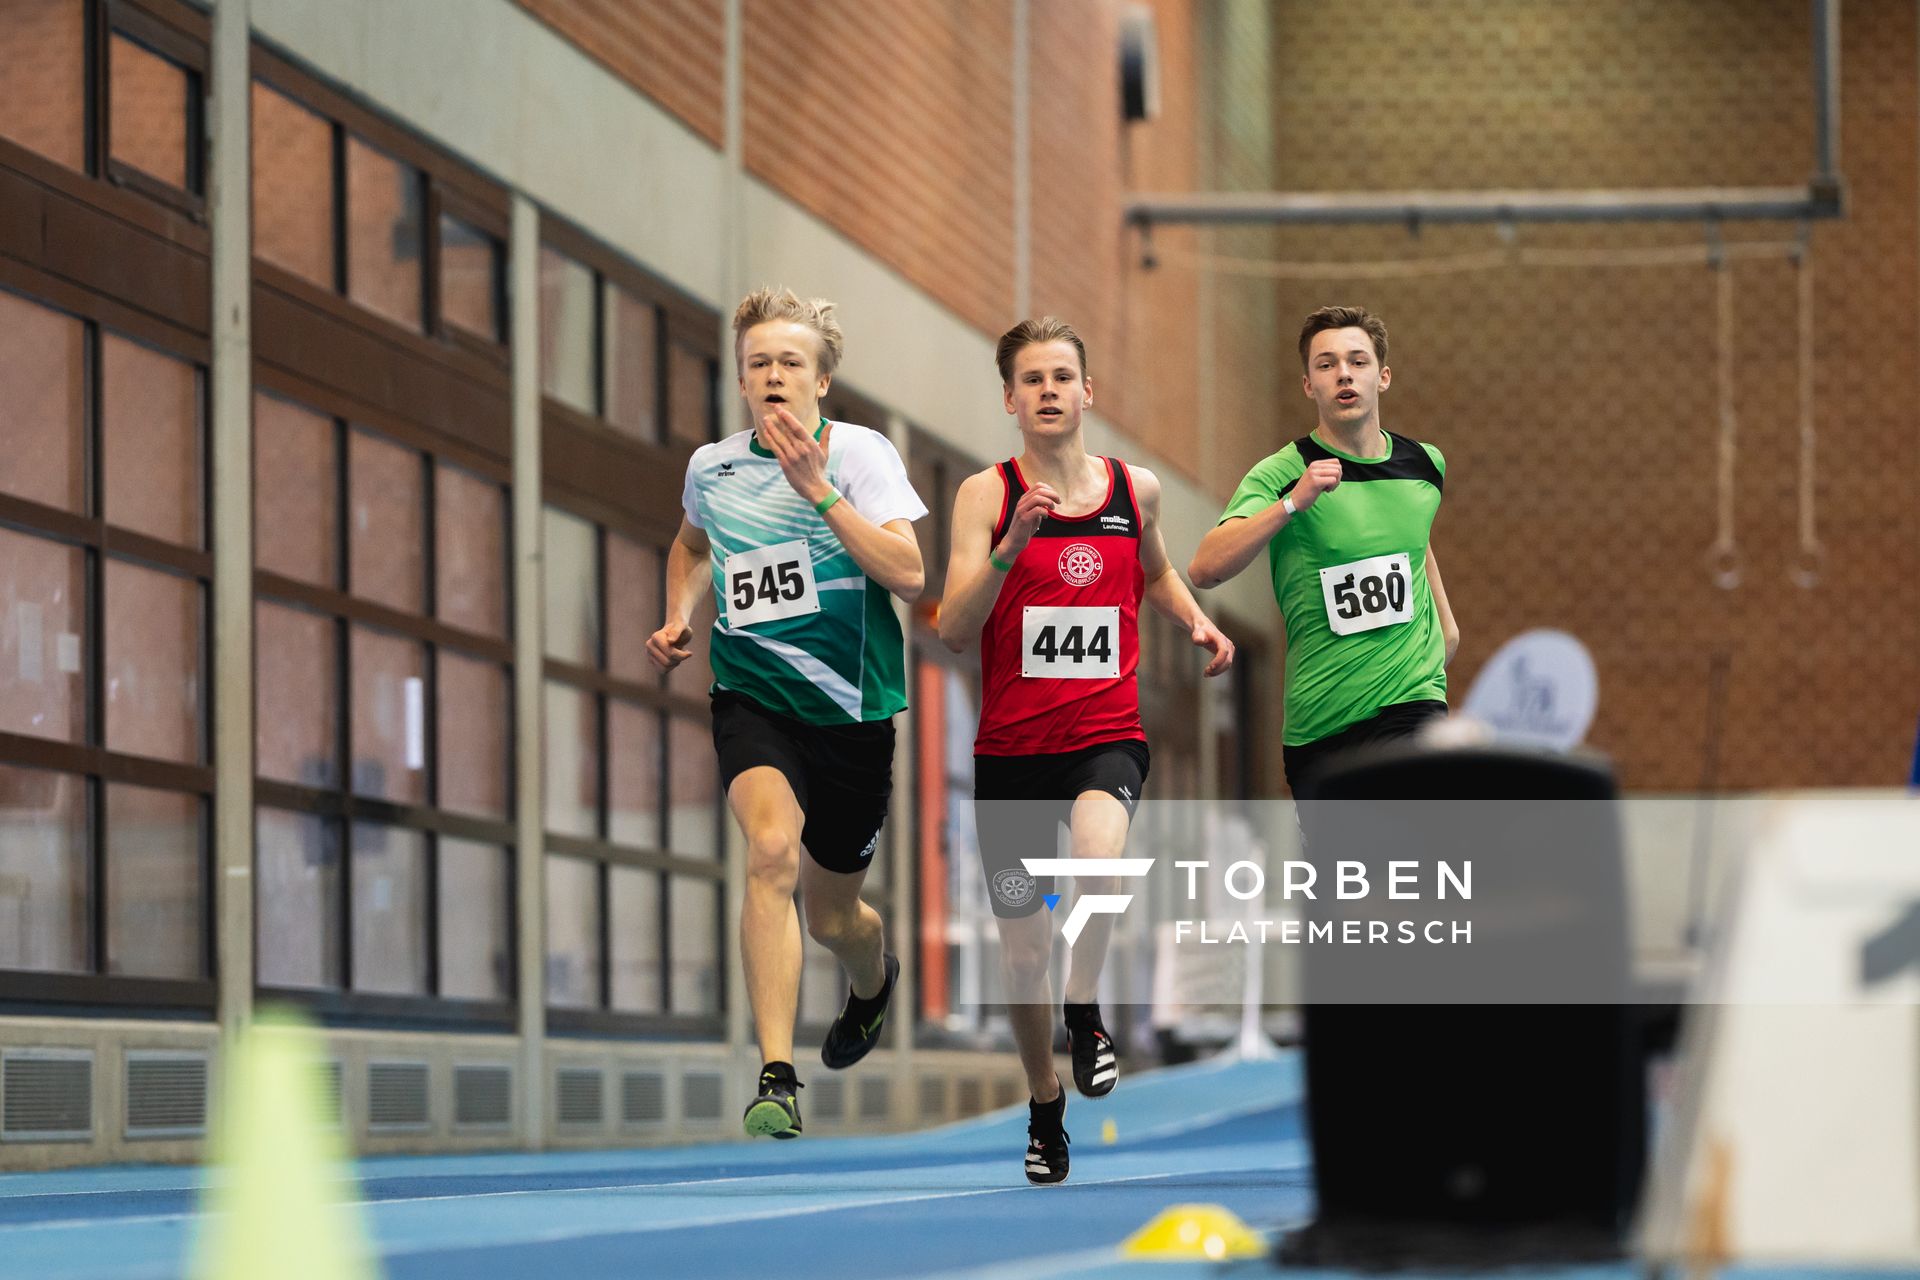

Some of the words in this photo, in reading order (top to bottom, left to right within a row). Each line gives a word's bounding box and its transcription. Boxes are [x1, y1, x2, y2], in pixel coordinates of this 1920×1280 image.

[732, 560, 805, 611] 545
[1060, 561, 1067, 570] L
[1094, 562, 1101, 571] G
[1333, 563, 1406, 619] 580
[1032, 625, 1111, 664] 444
